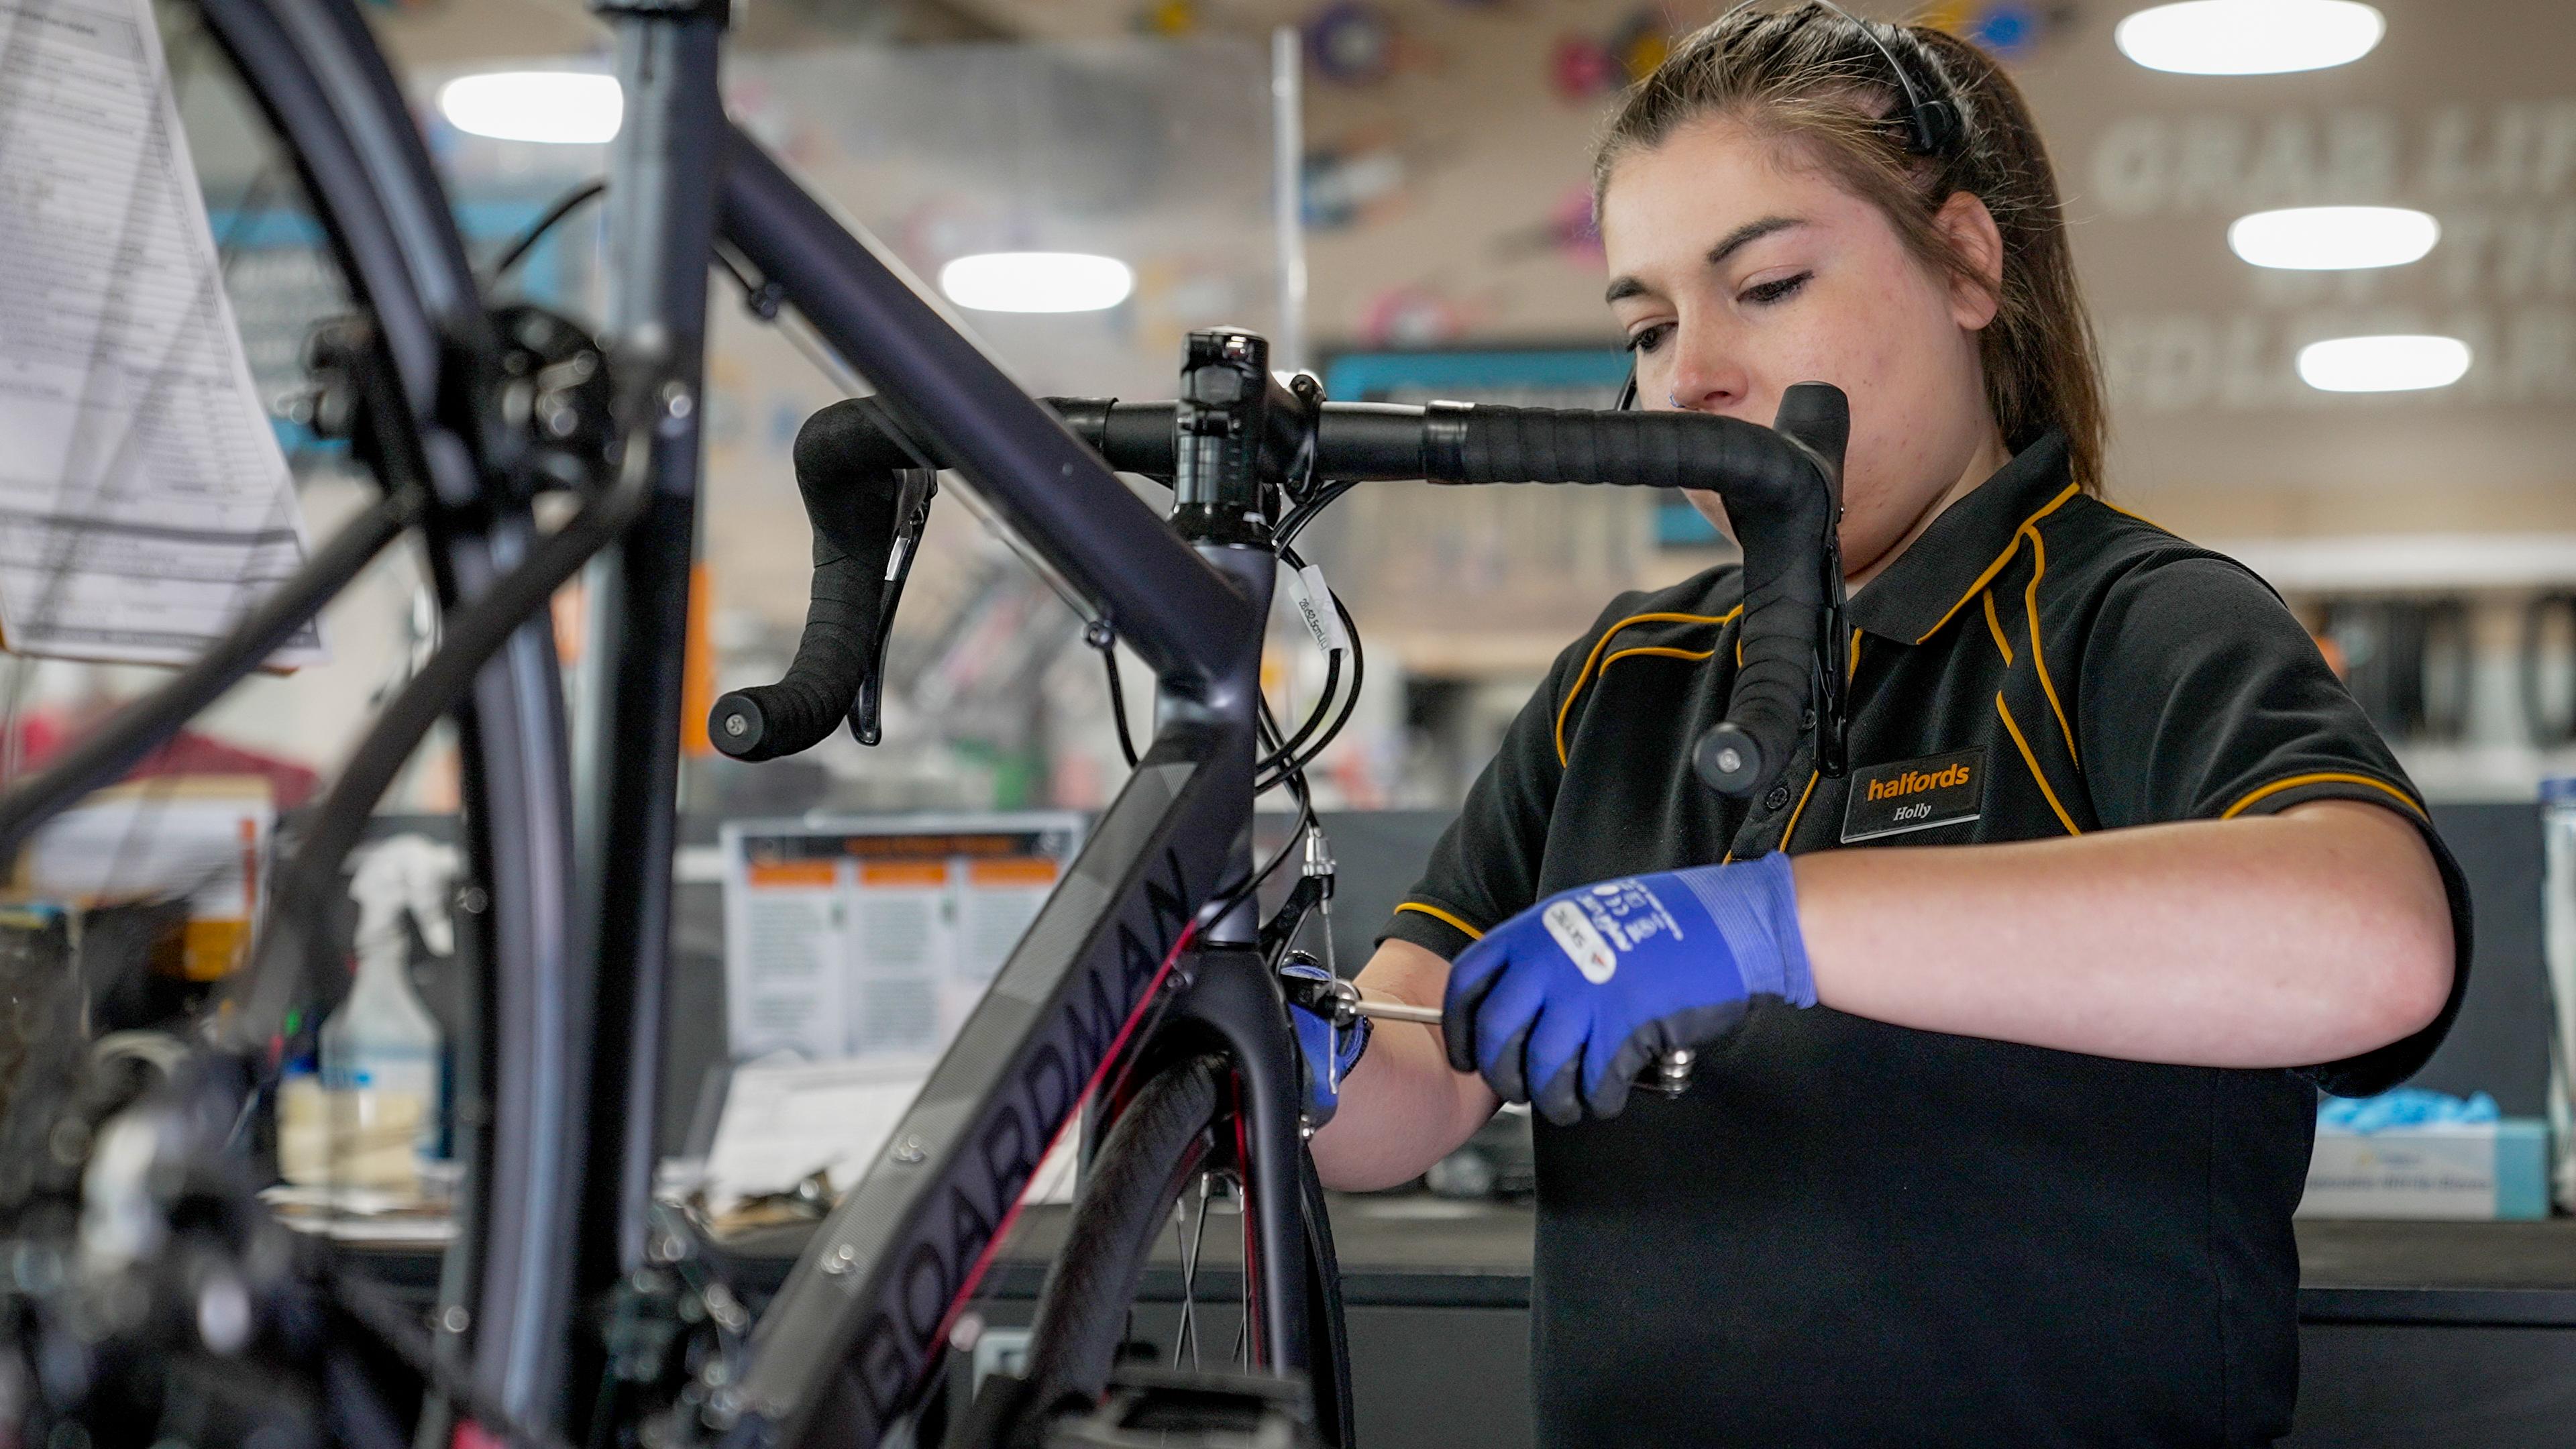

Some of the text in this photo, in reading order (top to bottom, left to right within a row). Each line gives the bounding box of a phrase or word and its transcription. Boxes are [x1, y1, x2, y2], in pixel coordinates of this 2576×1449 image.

[1867, 763, 1970, 802] halfords
[1893, 802, 1931, 821] Holly
[847, 847, 1191, 1421] BOARDMAN
